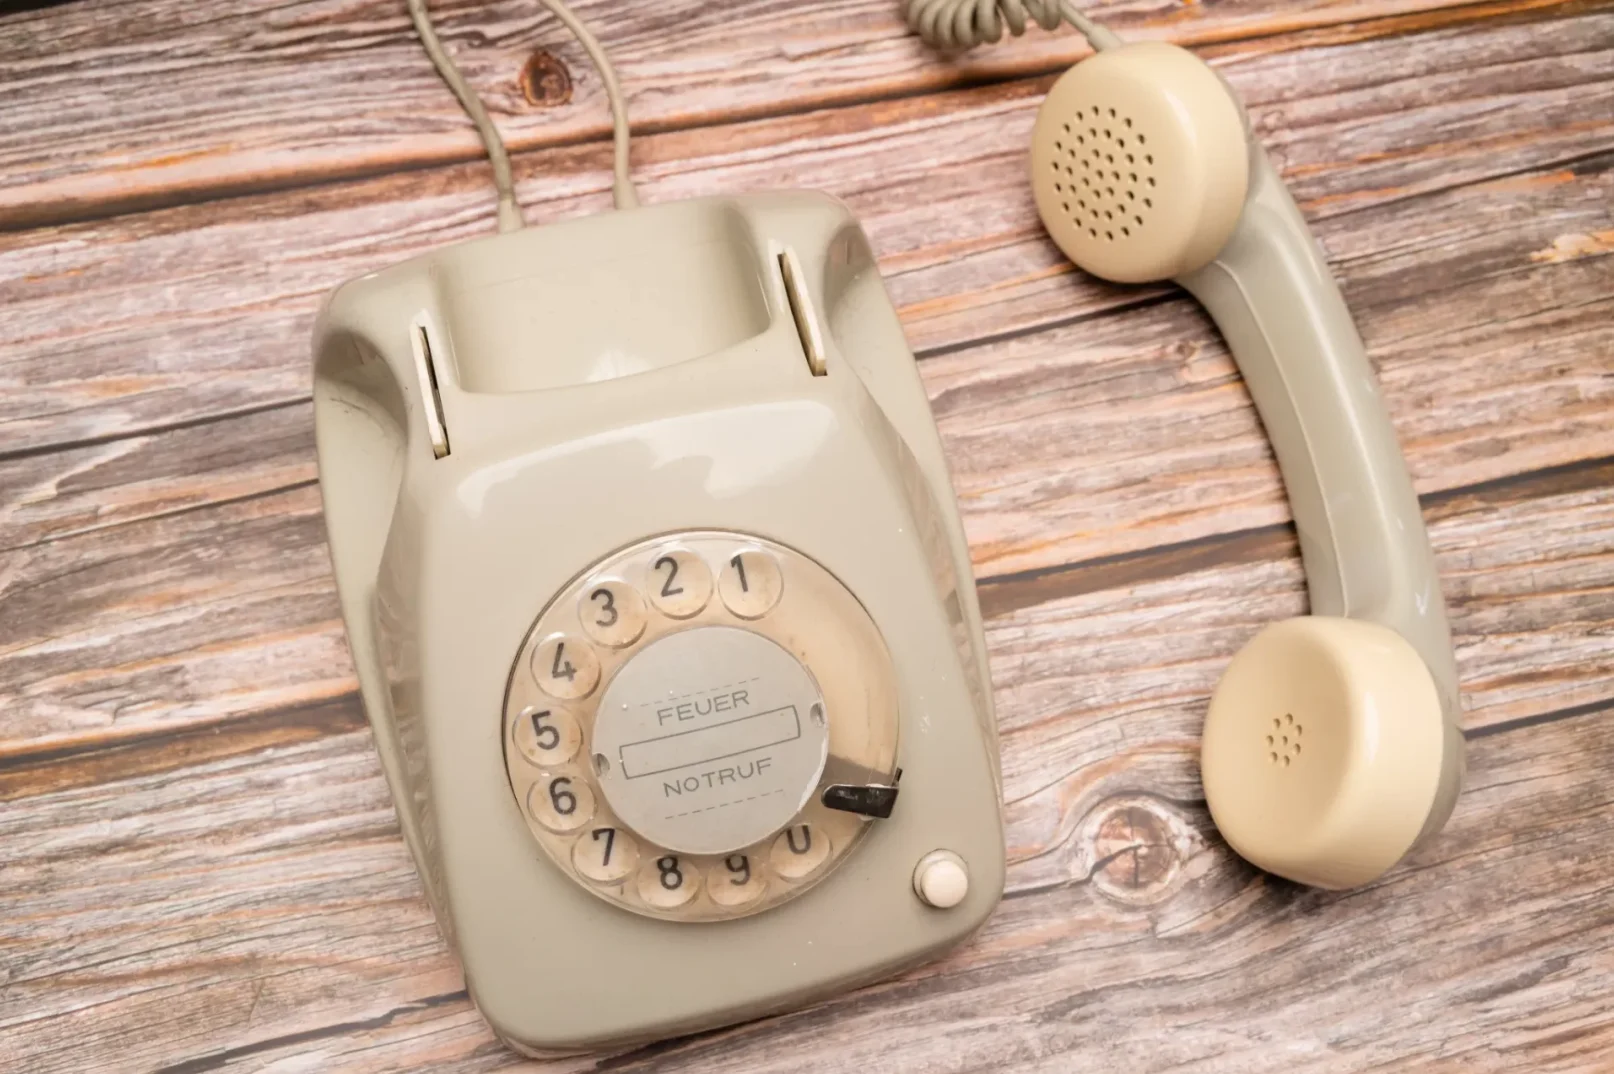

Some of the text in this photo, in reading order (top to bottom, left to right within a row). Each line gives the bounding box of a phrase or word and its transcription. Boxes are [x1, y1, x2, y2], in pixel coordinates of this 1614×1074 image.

[654, 556, 684, 597] 2
[730, 554, 749, 592] 1
[590, 588, 618, 627] 3
[551, 642, 577, 682] 4
[656, 689, 750, 726] FEUER
[531, 710, 560, 750] 5
[548, 777, 577, 815] 6
[662, 757, 772, 798] NOTRUF
[592, 827, 616, 866] 7
[656, 854, 683, 890] 8
[725, 855, 751, 886] 9
